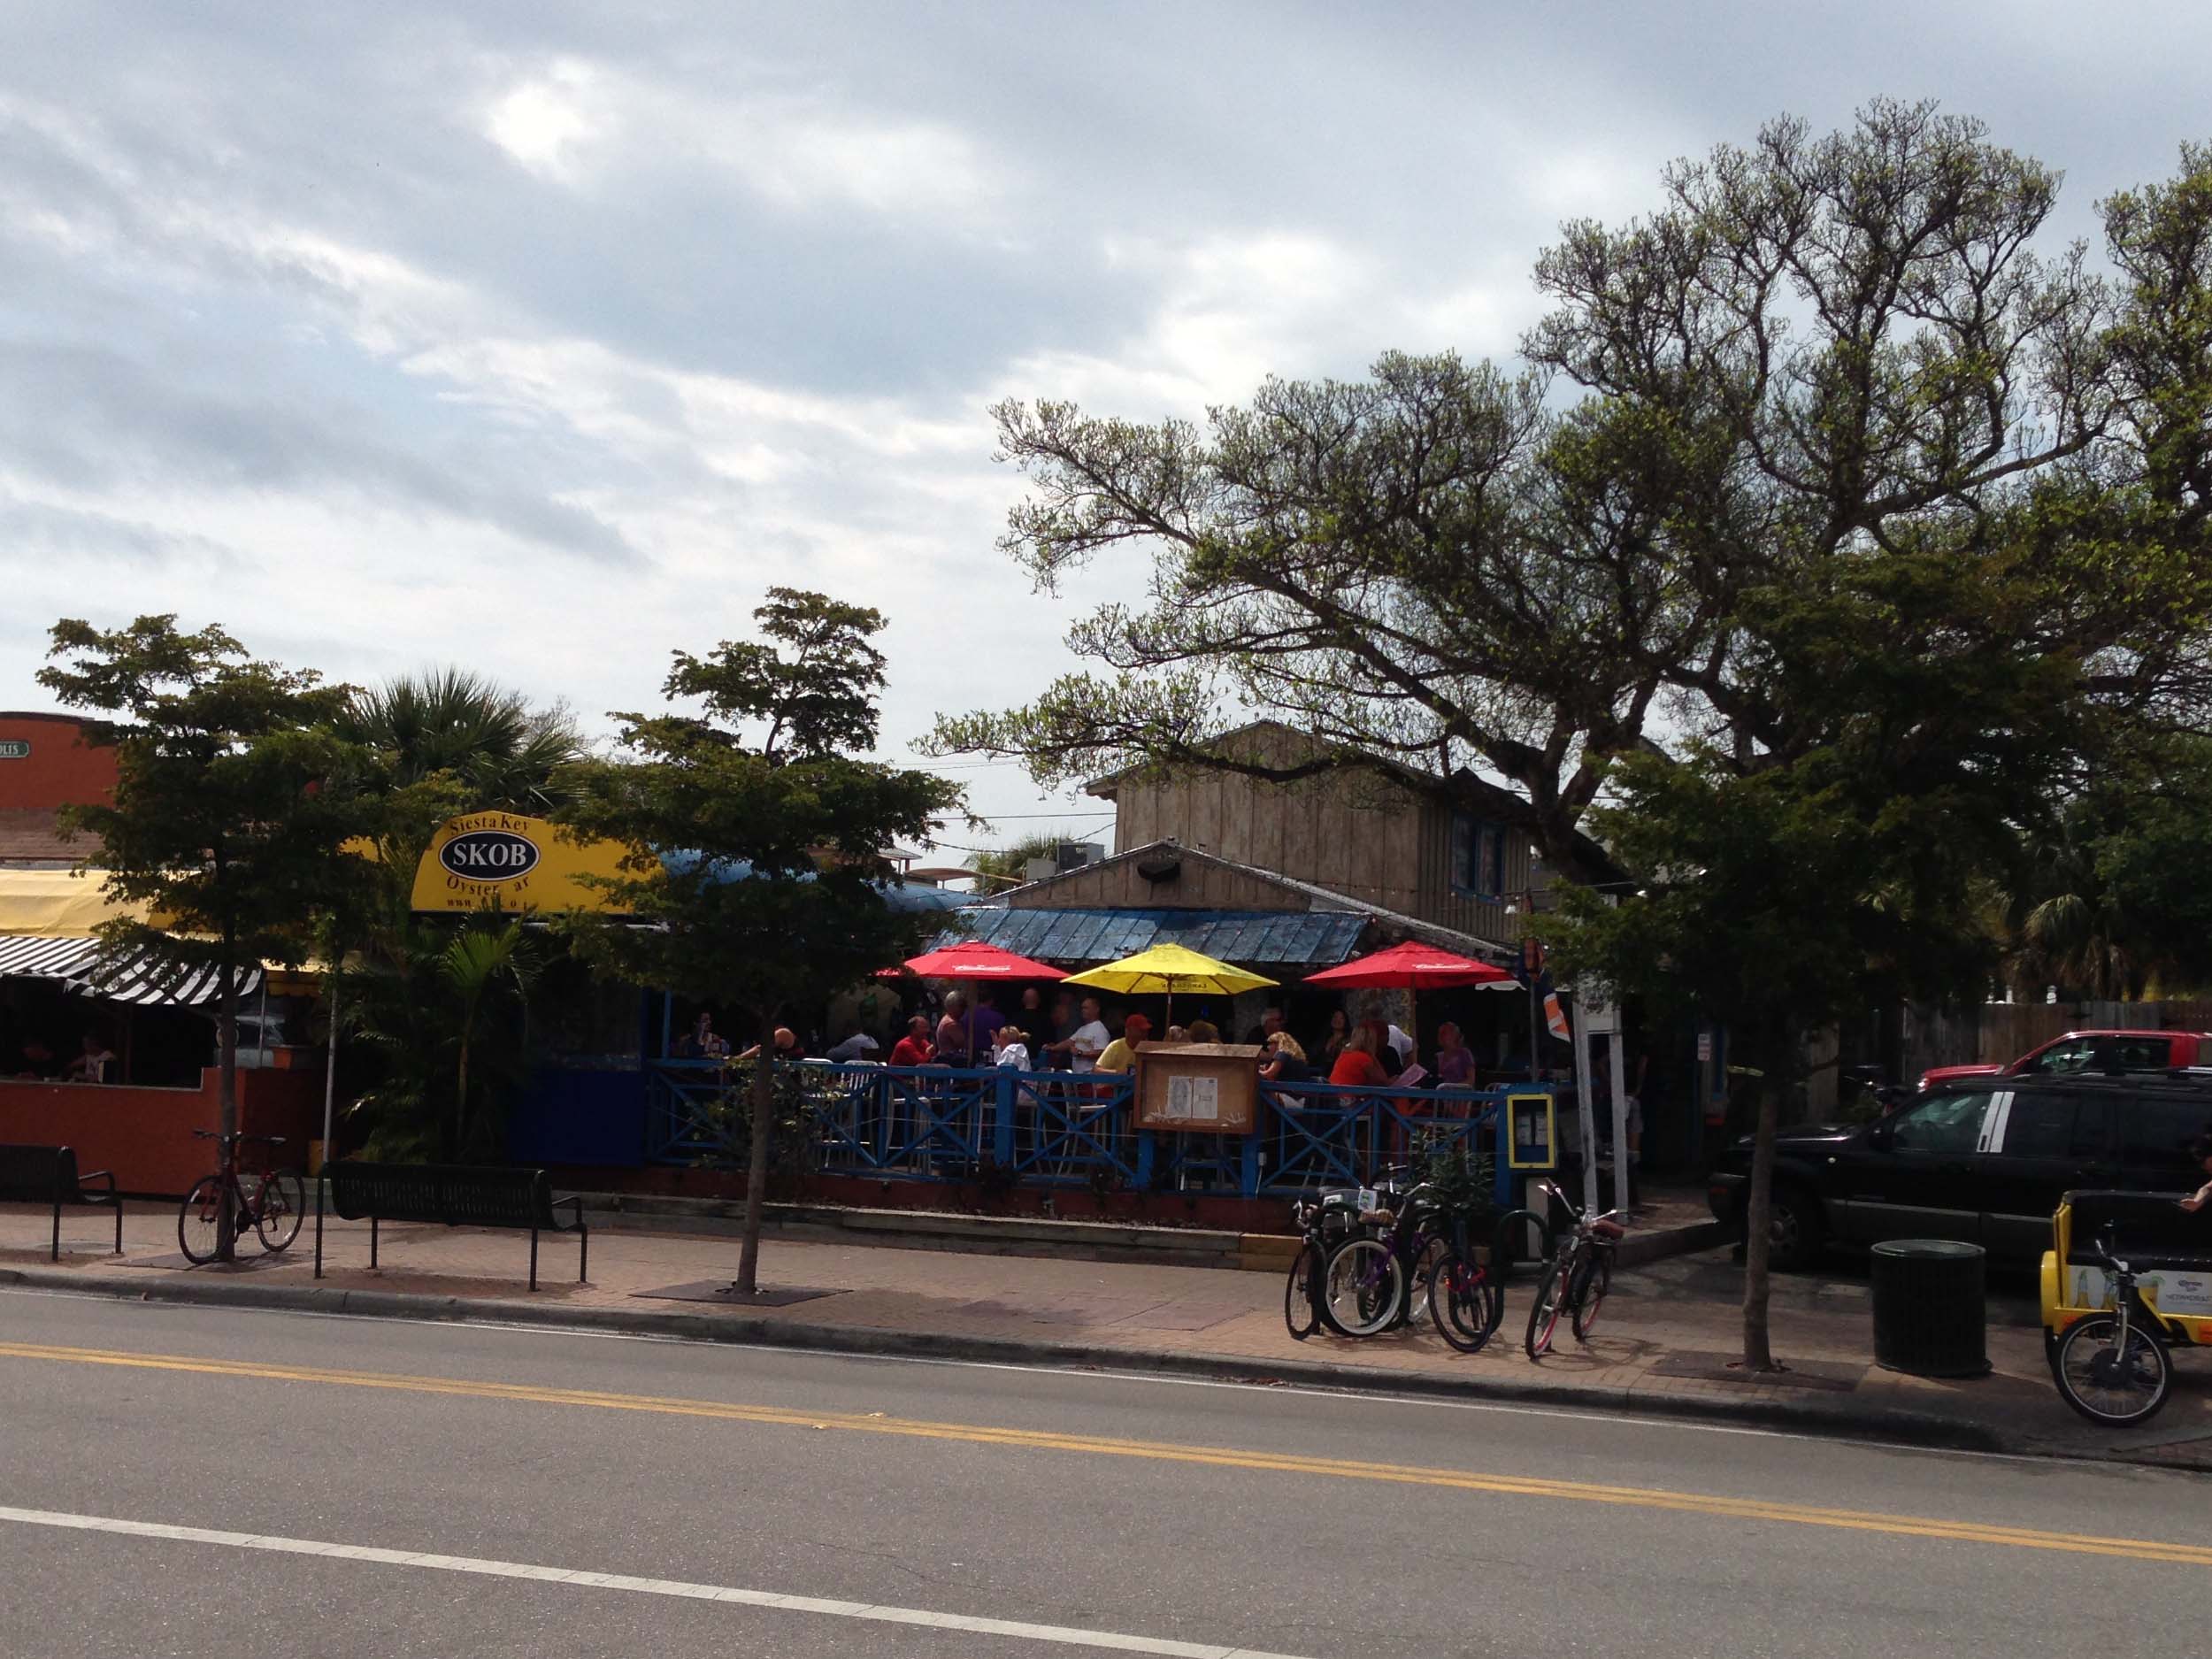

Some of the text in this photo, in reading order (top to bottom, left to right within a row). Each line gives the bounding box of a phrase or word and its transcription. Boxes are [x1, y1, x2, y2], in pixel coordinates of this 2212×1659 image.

[449, 815, 531, 835] Siesta Key
[454, 843, 526, 866] SKOB
[446, 875, 499, 896] Oyster
